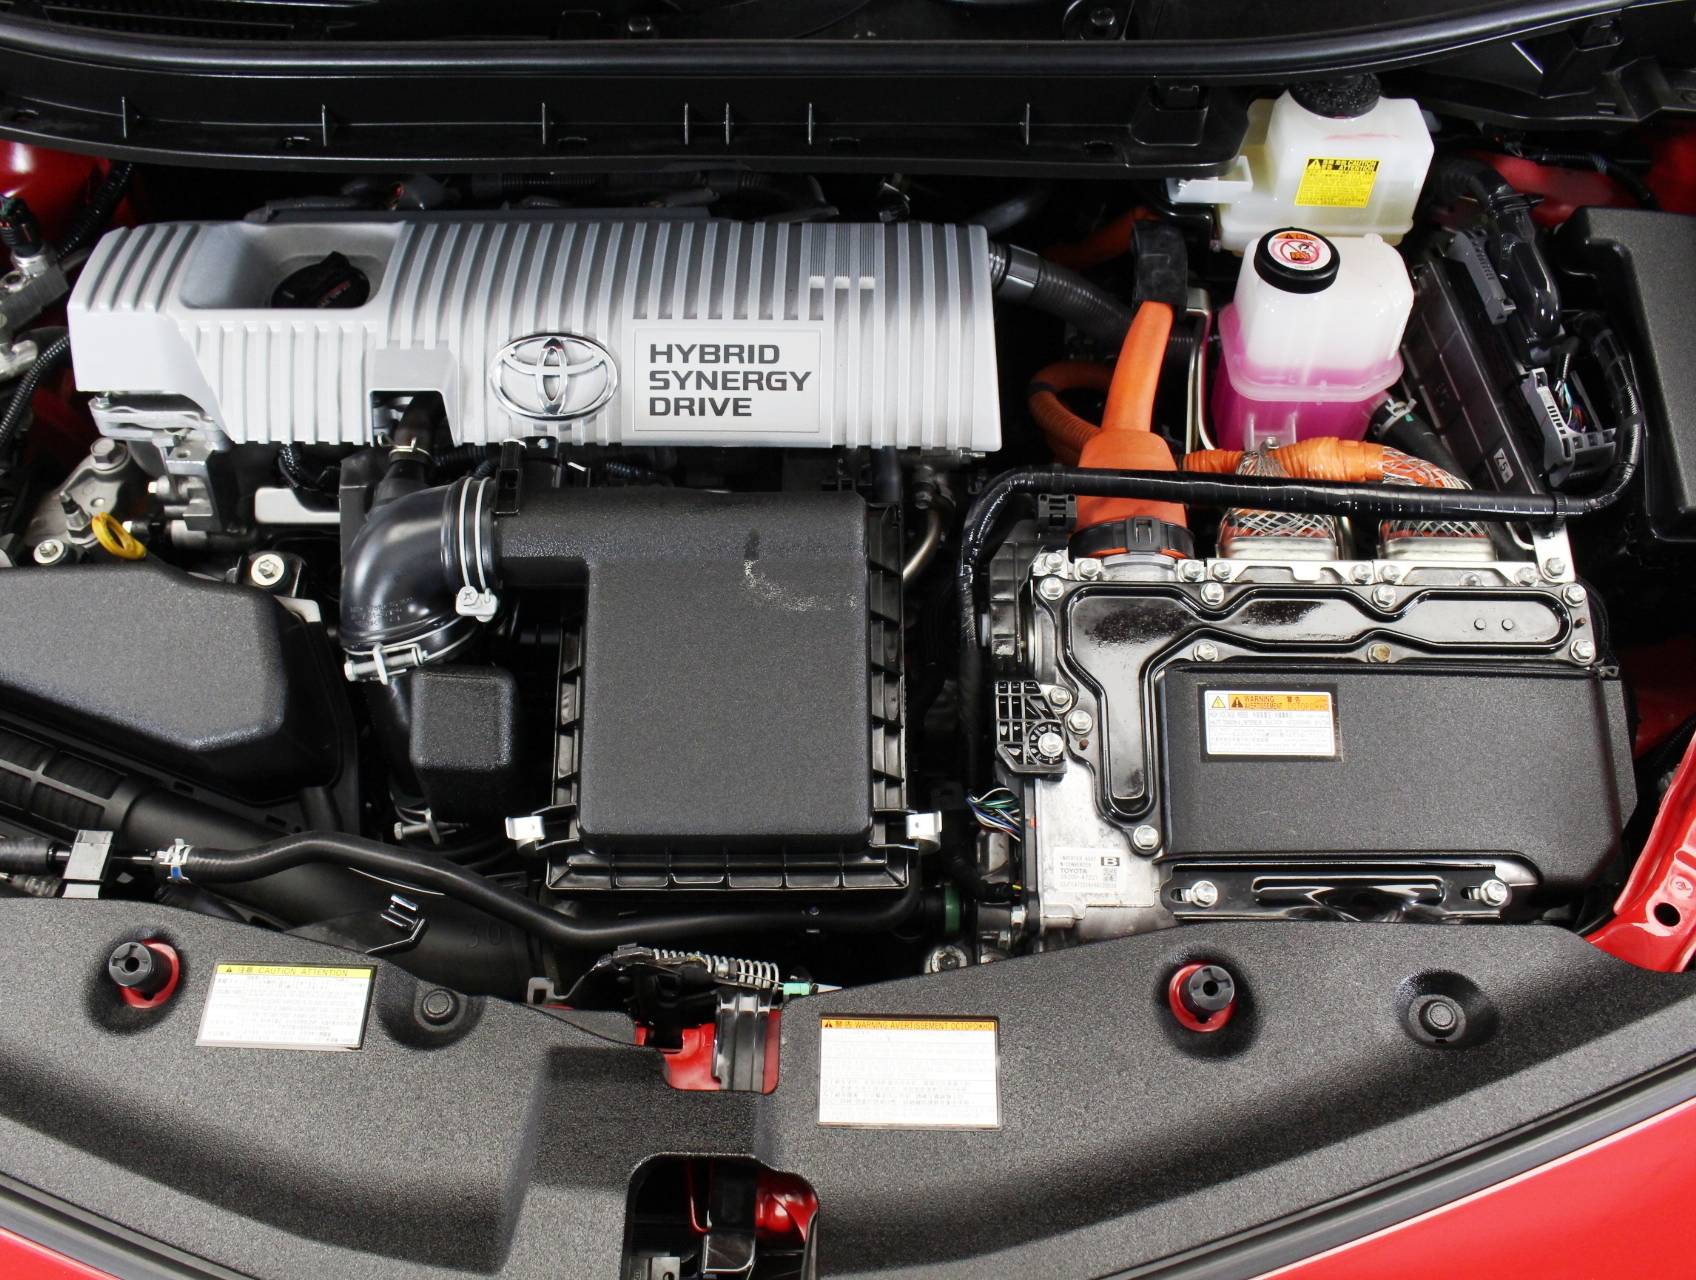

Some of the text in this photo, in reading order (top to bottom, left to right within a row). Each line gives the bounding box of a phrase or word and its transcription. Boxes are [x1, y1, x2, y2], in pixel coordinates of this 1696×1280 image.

[650, 344, 780, 364] HYBRID
[649, 370, 812, 391] SYNERGY
[649, 397, 752, 416] DRIVE
[1244, 695, 1275, 703] WARNING
[257, 966, 297, 975] CAUTION
[300, 967, 348, 977] ATTENTION
[855, 1021, 888, 1030] WARNING
[890, 1021, 948, 1031] AVERTISSEMENT
